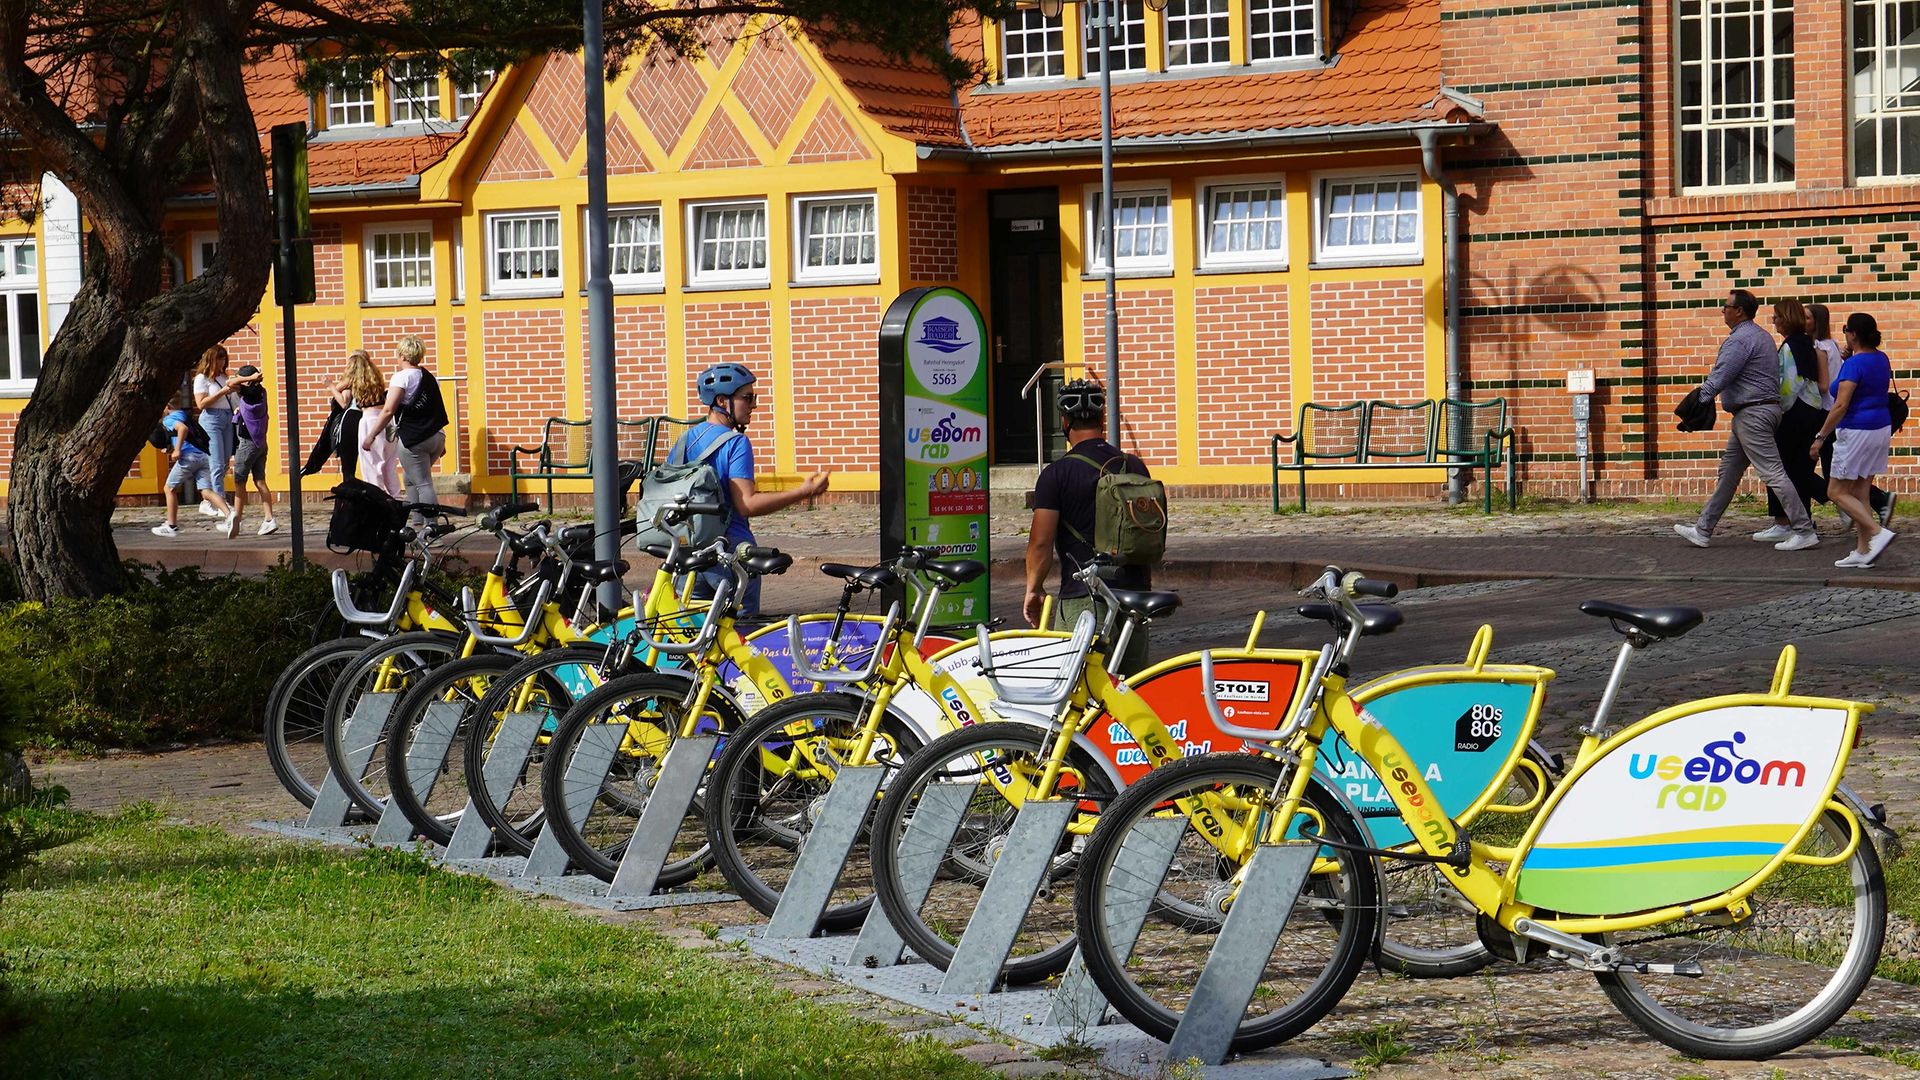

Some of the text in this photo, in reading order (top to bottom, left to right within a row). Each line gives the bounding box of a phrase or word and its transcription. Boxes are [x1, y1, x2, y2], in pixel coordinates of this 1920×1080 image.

[932, 373, 957, 385] 5563
[762, 646, 780, 658] Das
[1215, 683, 1266, 693] STOLZ
[1471, 704, 1503, 721] 80s
[1470, 720, 1502, 738] 80s
[1457, 742, 1480, 750] RADIO
